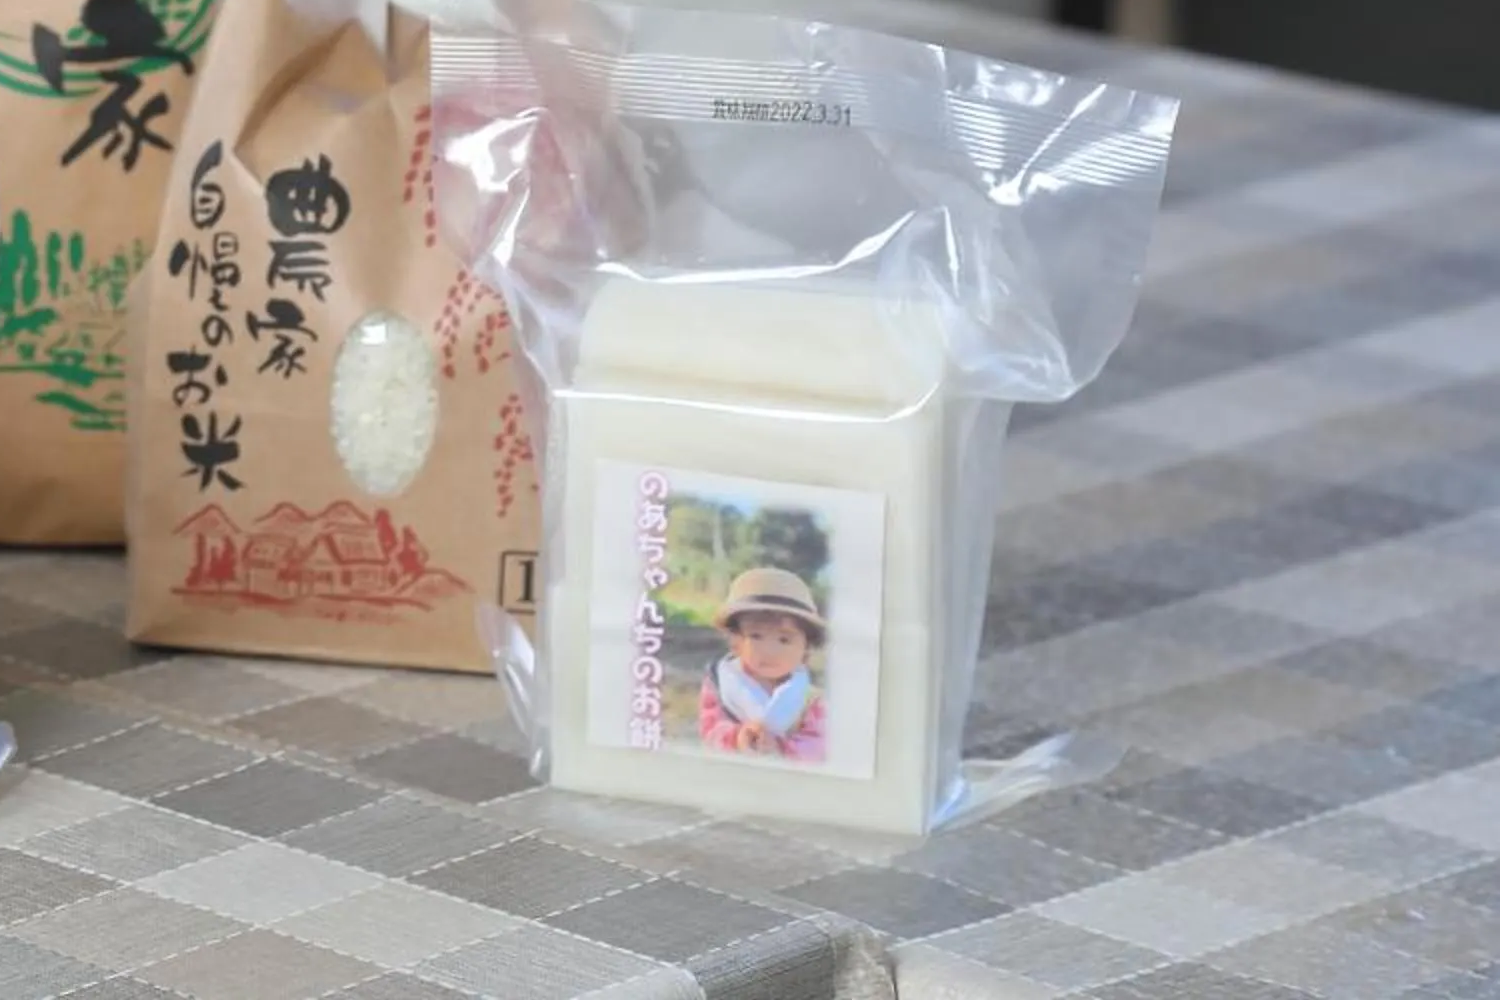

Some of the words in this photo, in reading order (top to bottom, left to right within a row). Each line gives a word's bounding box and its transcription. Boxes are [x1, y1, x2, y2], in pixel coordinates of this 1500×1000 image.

[167, 140, 244, 492] 自慢のお米
[247, 153, 350, 379] 農家
[631, 471, 668, 750] のあちゃんちのお餅
